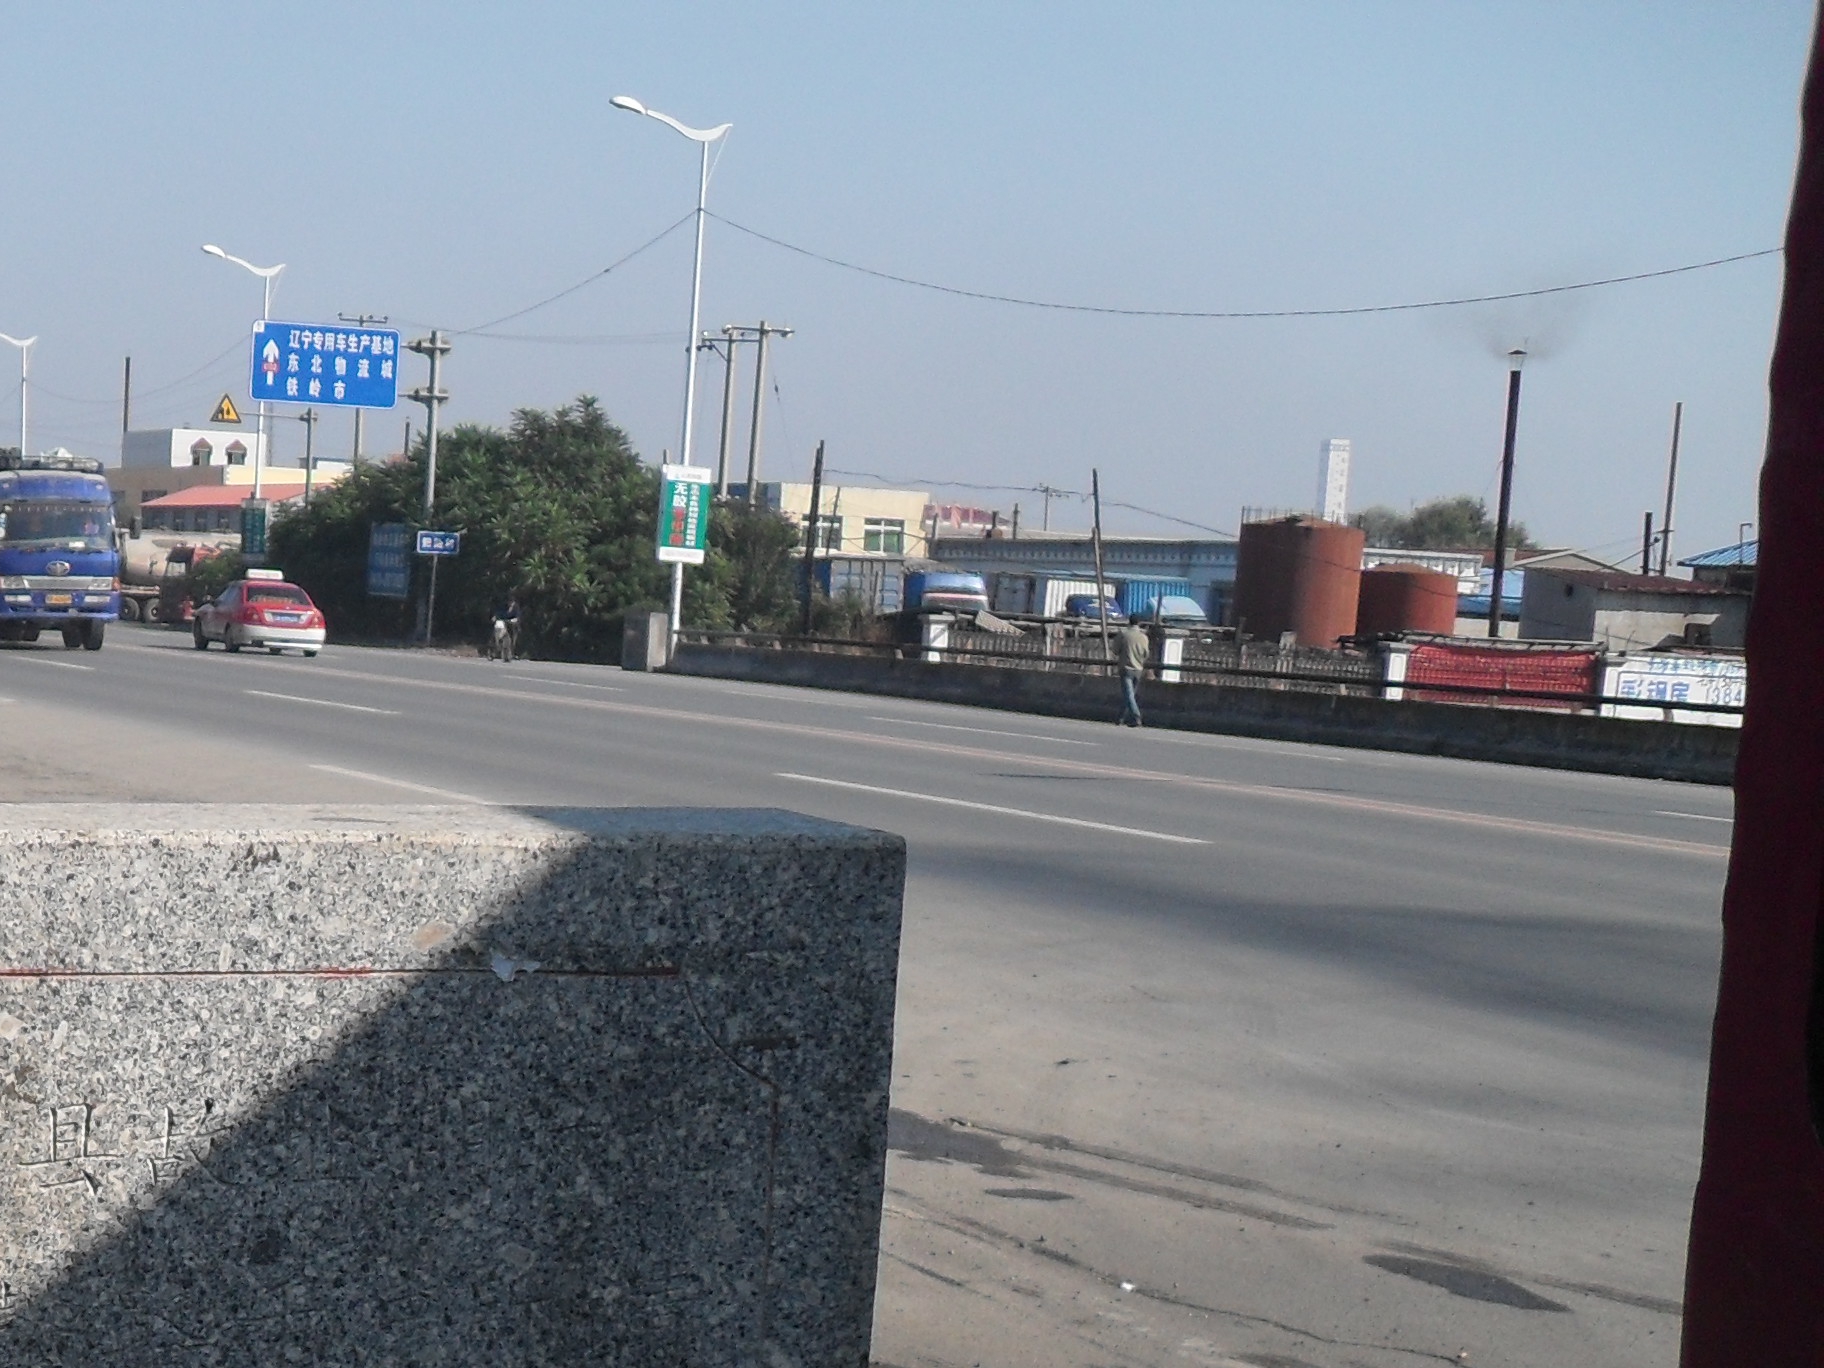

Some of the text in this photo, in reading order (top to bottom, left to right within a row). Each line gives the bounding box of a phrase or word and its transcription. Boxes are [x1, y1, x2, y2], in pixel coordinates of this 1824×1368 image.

[289, 329, 395, 356] 辽宁专用车生产基地
[286, 376, 346, 399] 铁岭市
